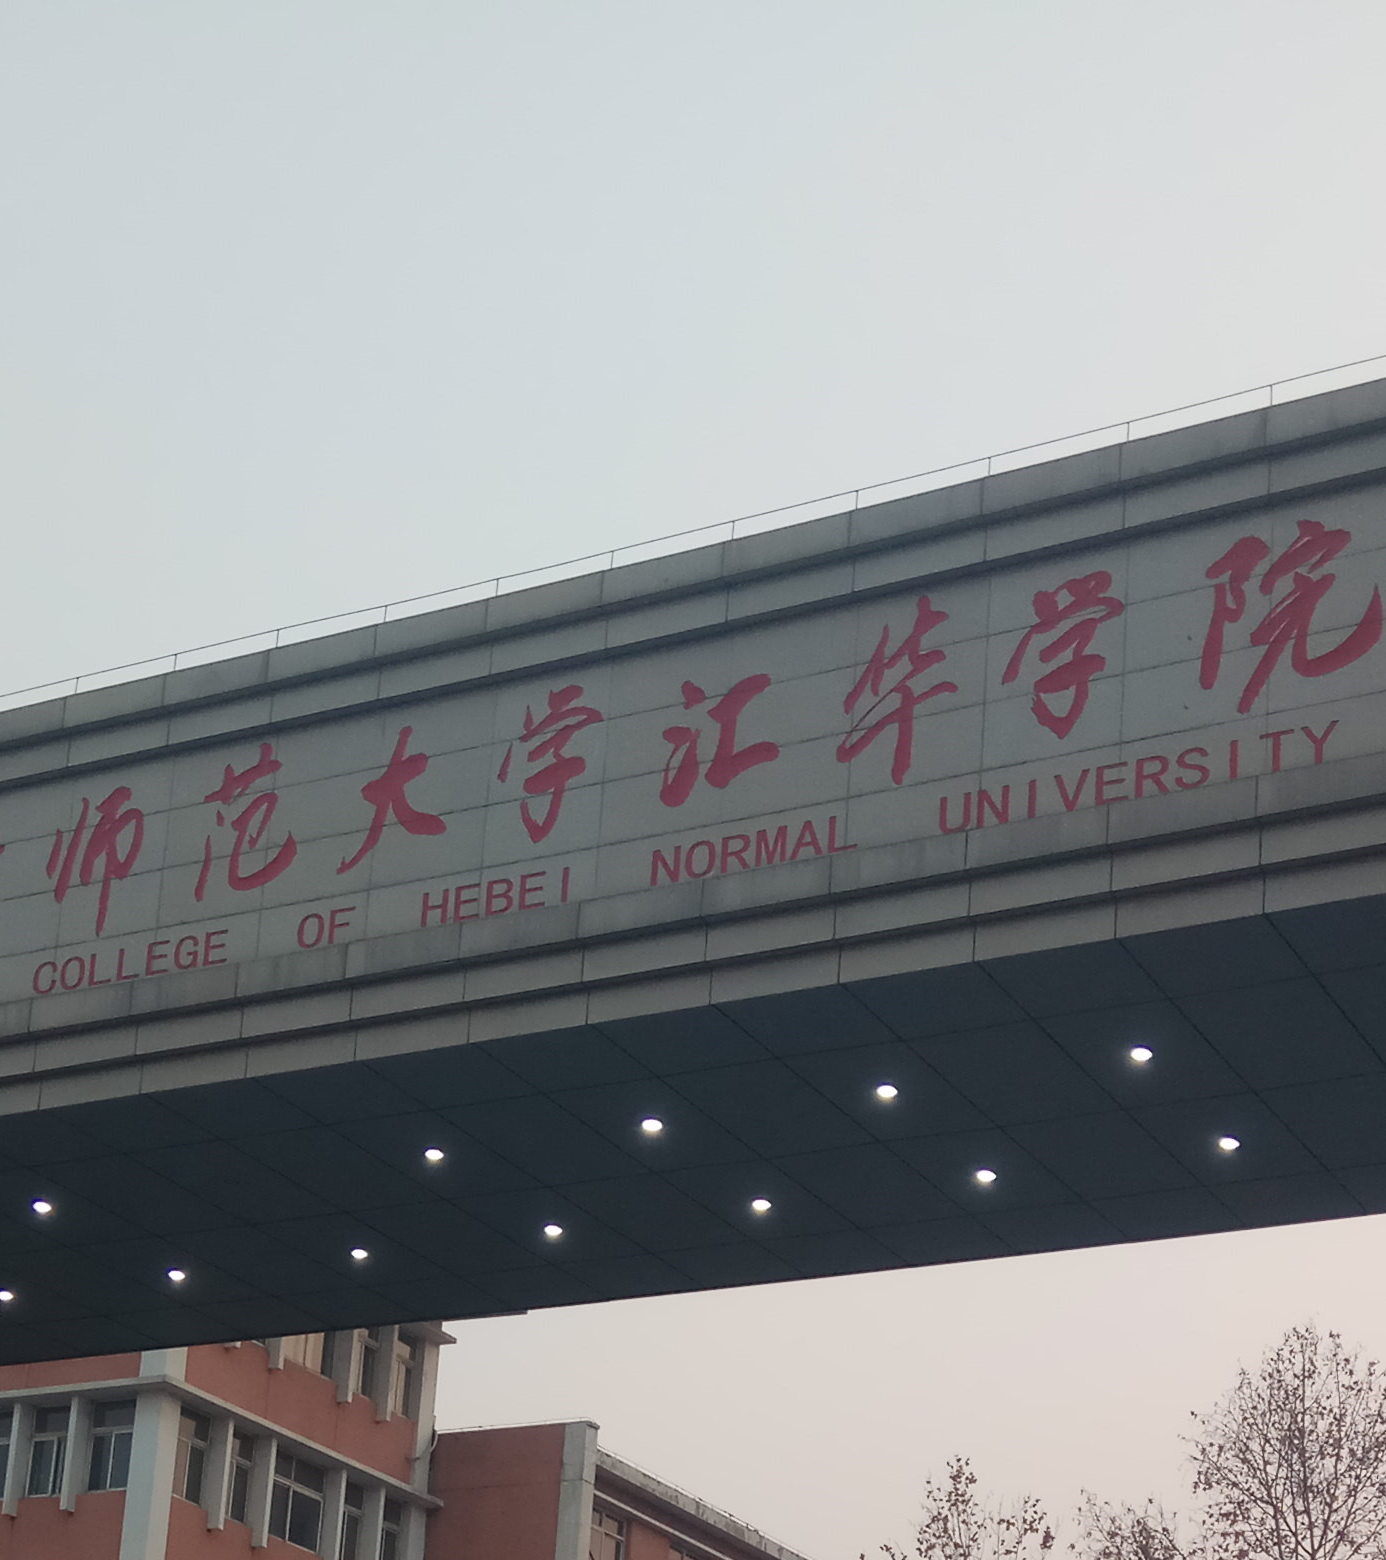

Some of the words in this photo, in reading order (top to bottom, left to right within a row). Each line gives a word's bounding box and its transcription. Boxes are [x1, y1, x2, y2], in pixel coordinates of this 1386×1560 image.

[32, 930, 229, 995] COLLEGE
[297, 907, 356, 951] OF
[420, 867, 570, 927] HEBEI
[649, 815, 857, 887] NORMAL
[939, 720, 1340, 835] UNIVERSITY
